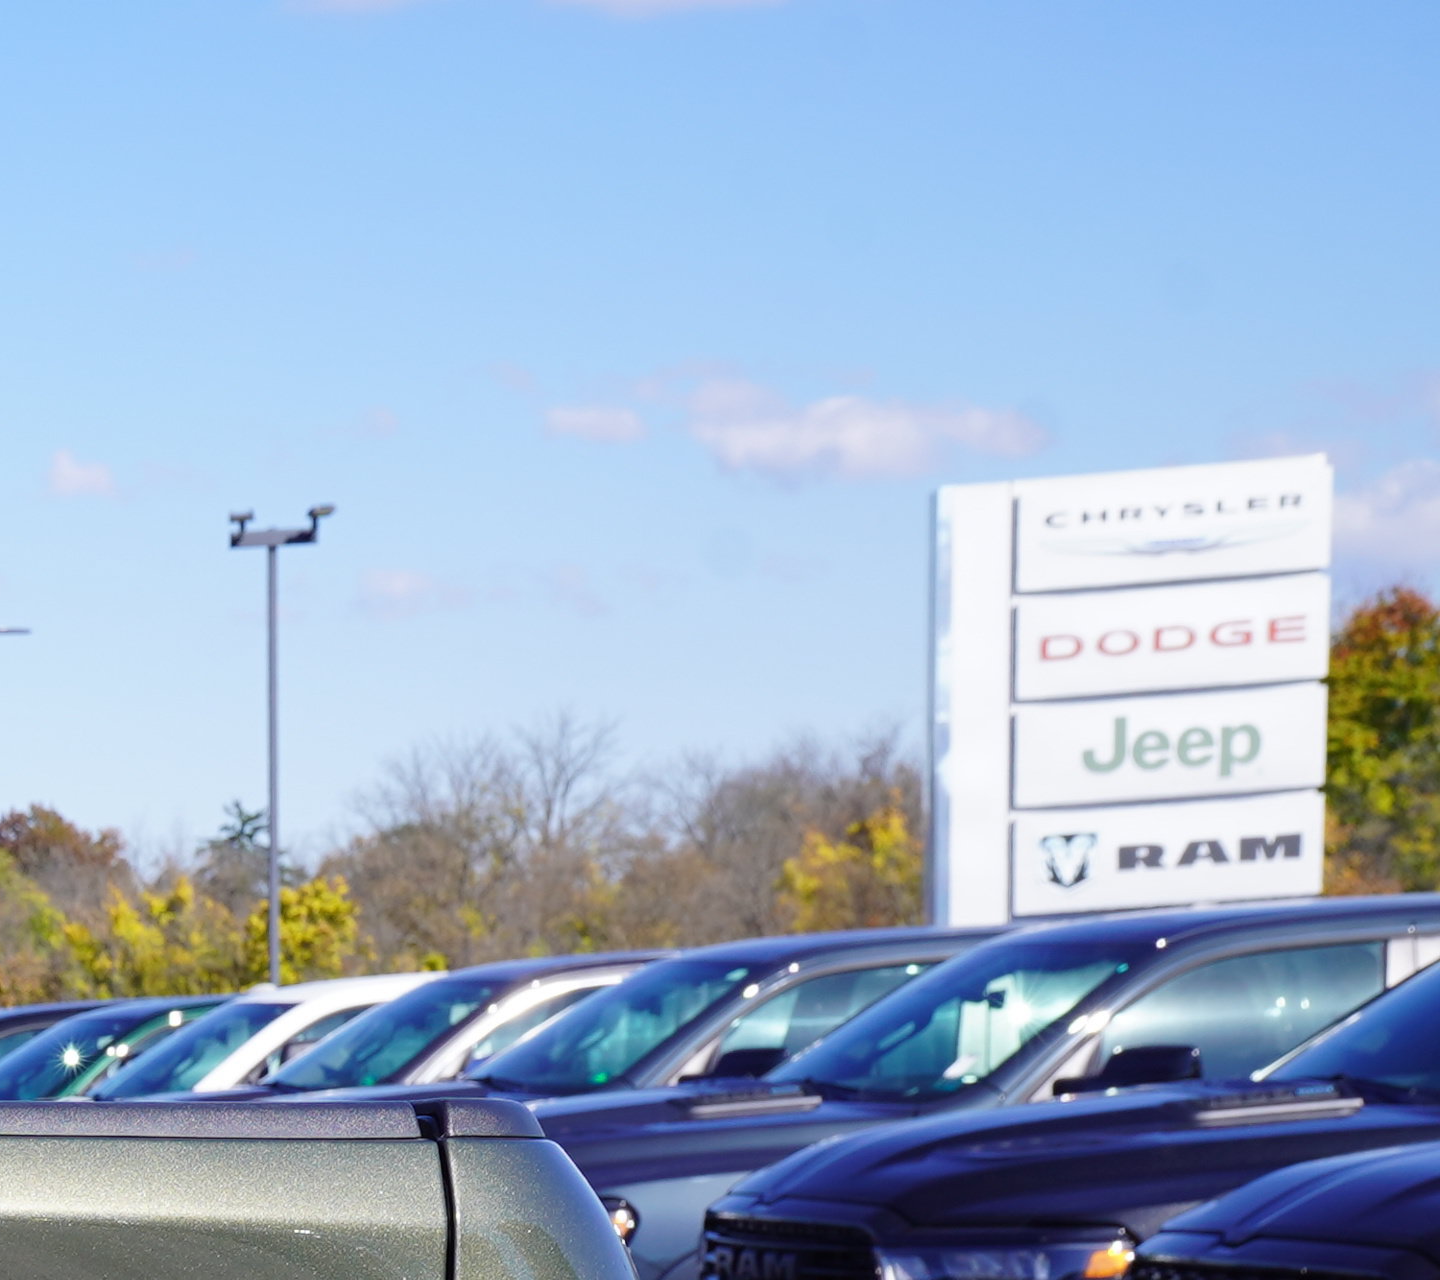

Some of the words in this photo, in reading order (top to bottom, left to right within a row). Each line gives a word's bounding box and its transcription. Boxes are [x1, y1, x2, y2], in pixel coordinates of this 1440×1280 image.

[1044, 494, 1303, 528] CHRYSLER
[1039, 614, 1308, 662] DODGE
[1082, 716, 1262, 777] Jeep
[1117, 833, 1302, 872] RAM
